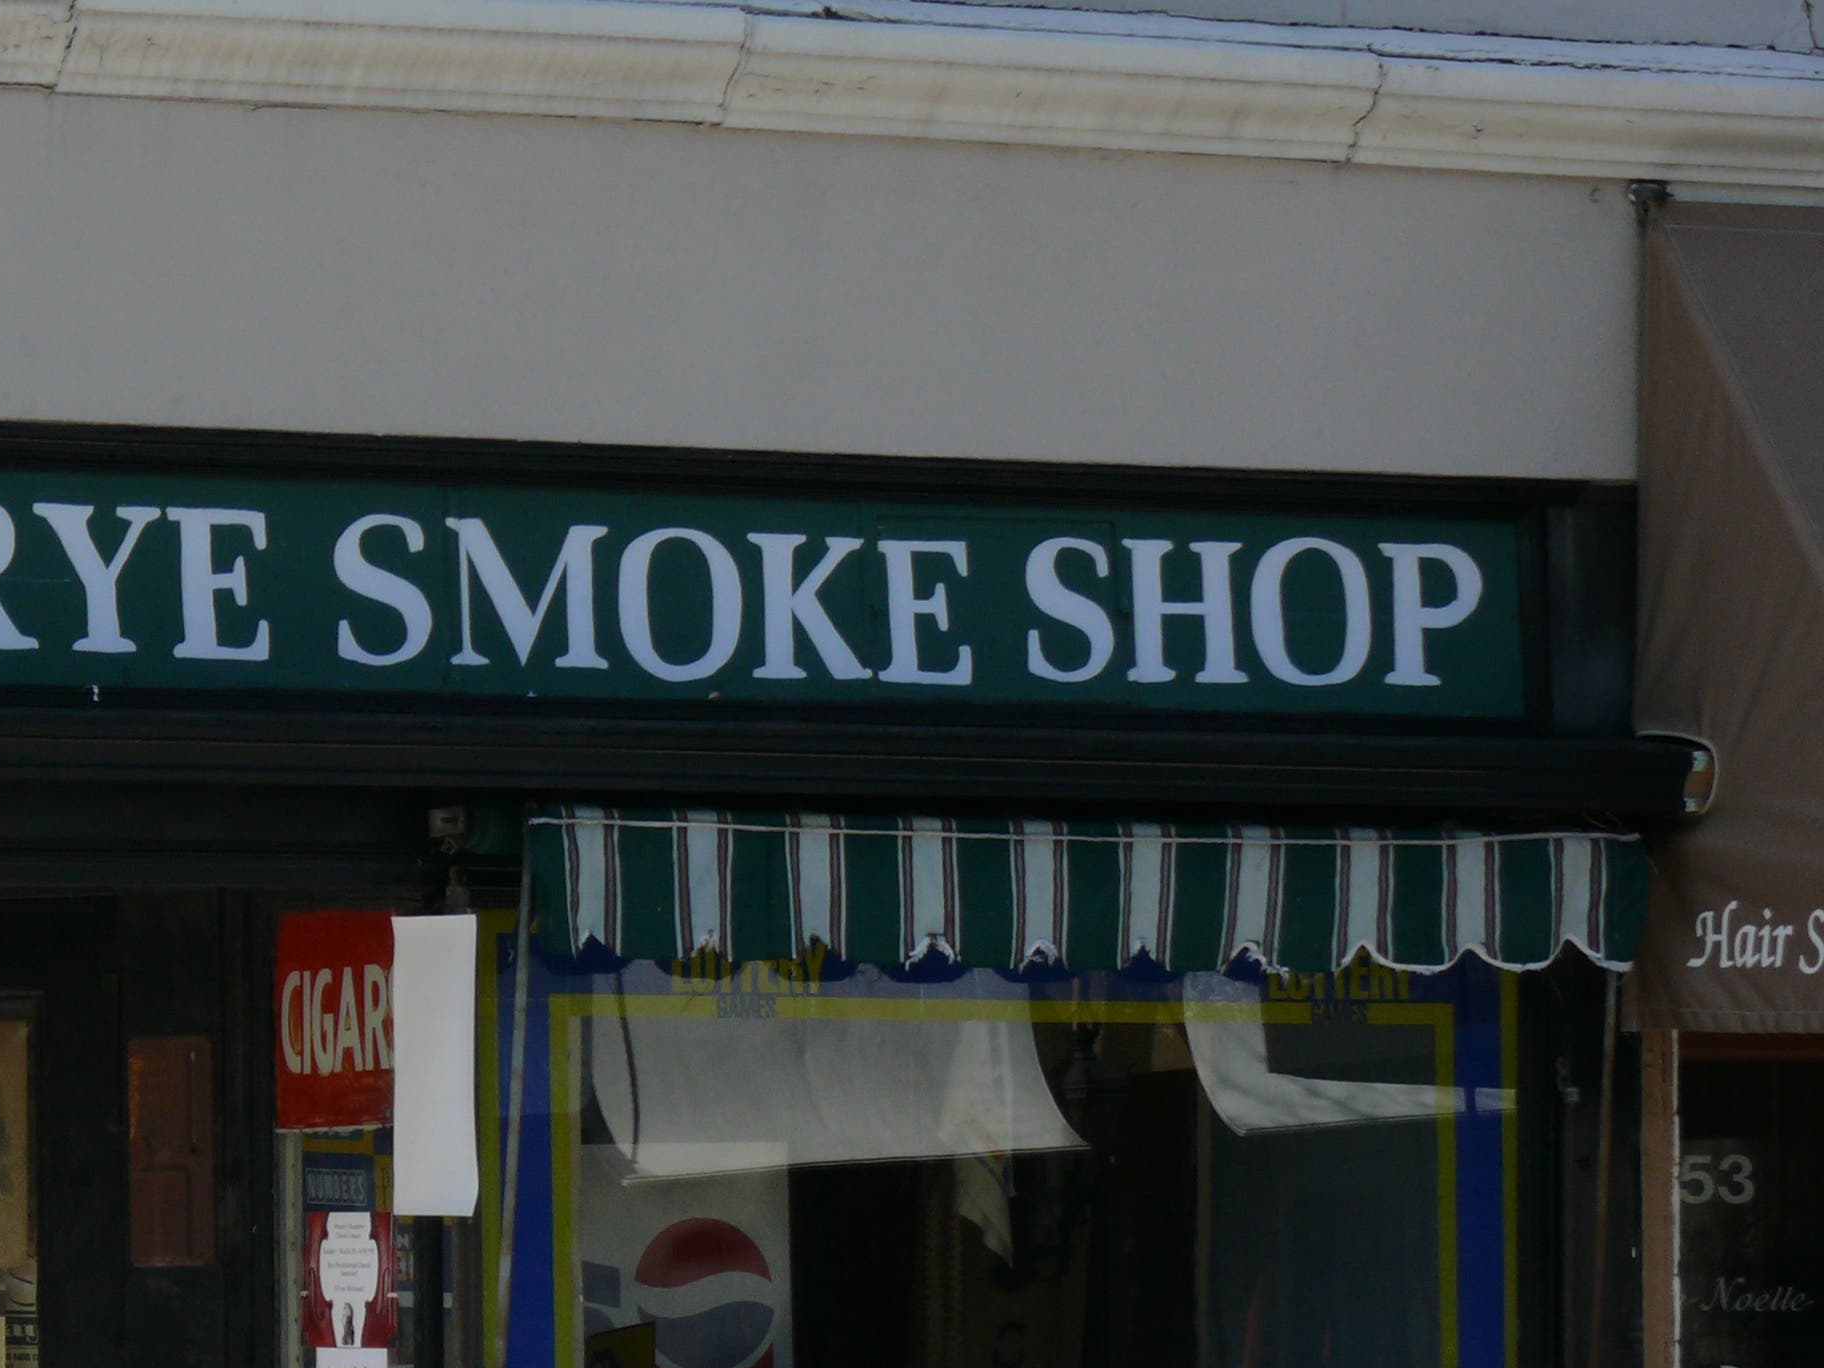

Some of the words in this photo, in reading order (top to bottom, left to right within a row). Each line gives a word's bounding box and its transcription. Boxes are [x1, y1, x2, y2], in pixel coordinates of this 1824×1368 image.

[332, 512, 973, 684] SMOKE
[1024, 535, 1483, 686] SHOP
[1687, 901, 1793, 969] Hair
[281, 963, 395, 1076] CIGAR
[1679, 1154, 1755, 1204] 53
